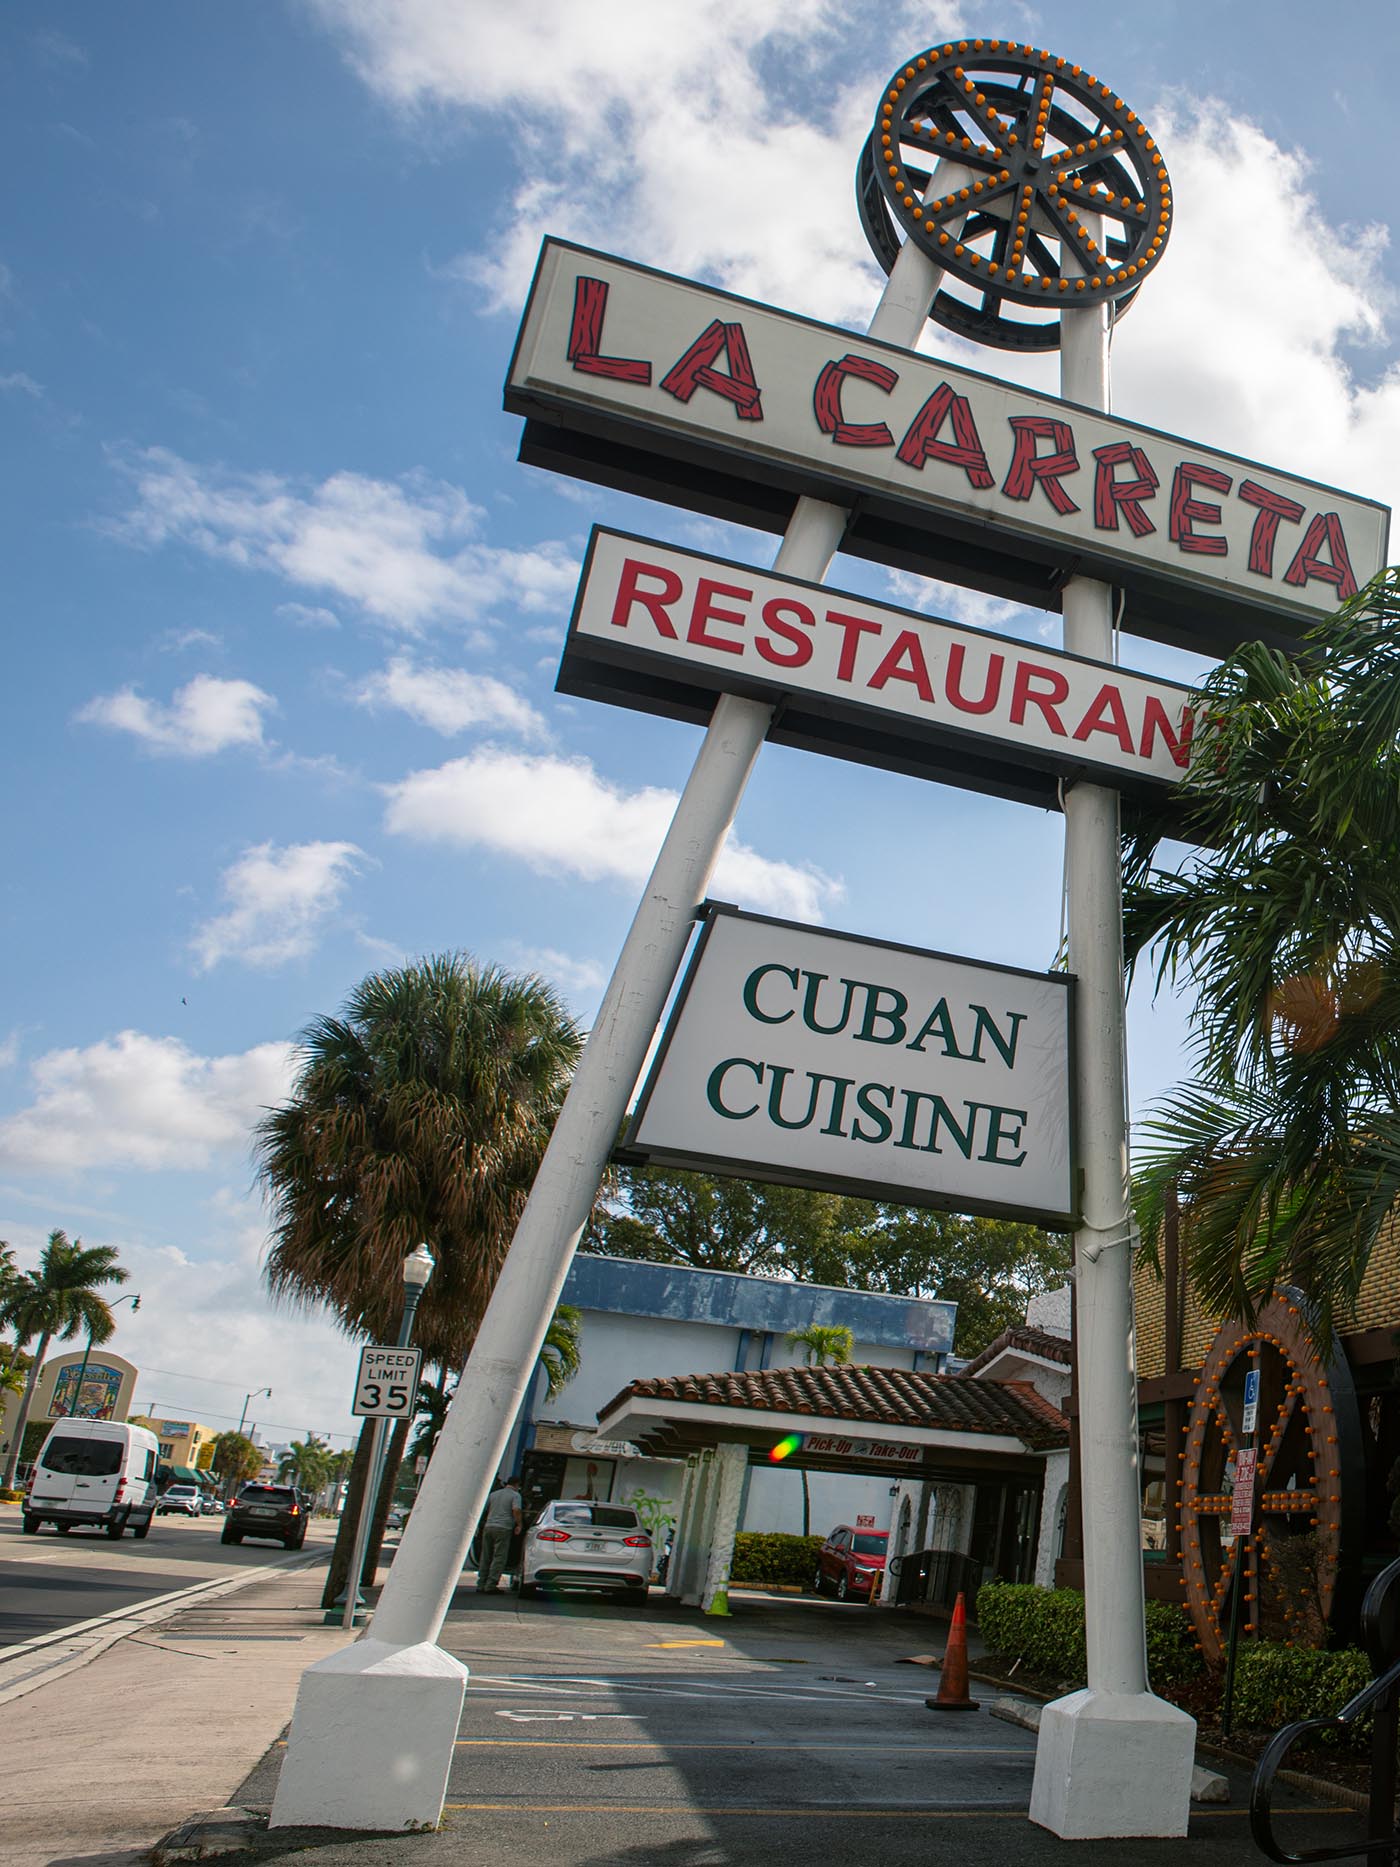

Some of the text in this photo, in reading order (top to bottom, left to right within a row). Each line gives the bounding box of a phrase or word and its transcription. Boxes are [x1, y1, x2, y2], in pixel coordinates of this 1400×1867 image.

[566, 275, 1360, 601] LA CARRETA
[743, 963, 1028, 1070] CUBAN
[706, 1057, 1028, 1168] CUISINE
[365, 1353, 415, 1367] SPEED
[368, 1368, 408, 1380] LIMIT
[359, 1383, 408, 1411] 35
[807, 1437, 920, 1460] Pick-Up Take-Out
